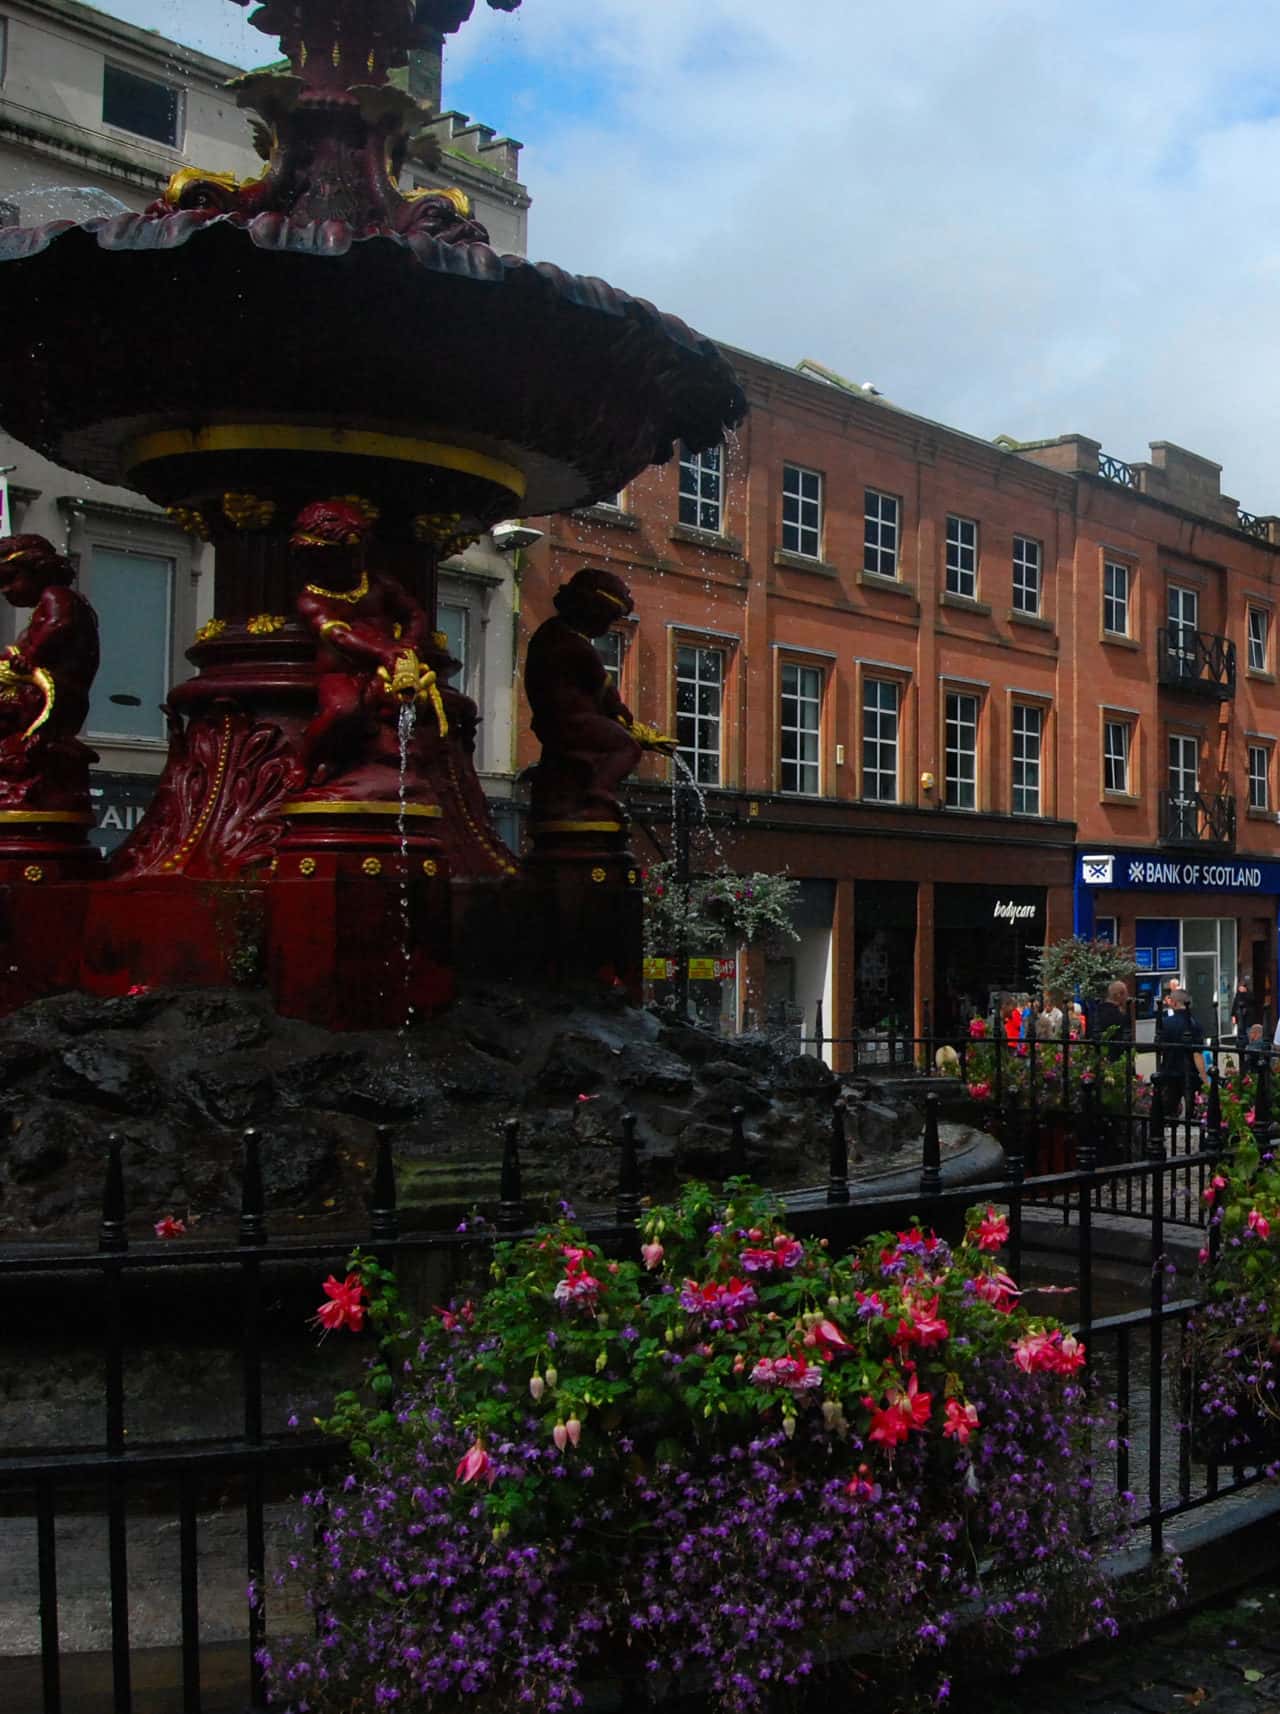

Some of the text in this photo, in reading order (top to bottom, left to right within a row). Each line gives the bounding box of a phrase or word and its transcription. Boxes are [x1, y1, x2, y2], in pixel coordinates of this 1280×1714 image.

[1146, 863, 1261, 886] BANK OF SCOTLAND
[993, 900, 1036, 925] bodycare
